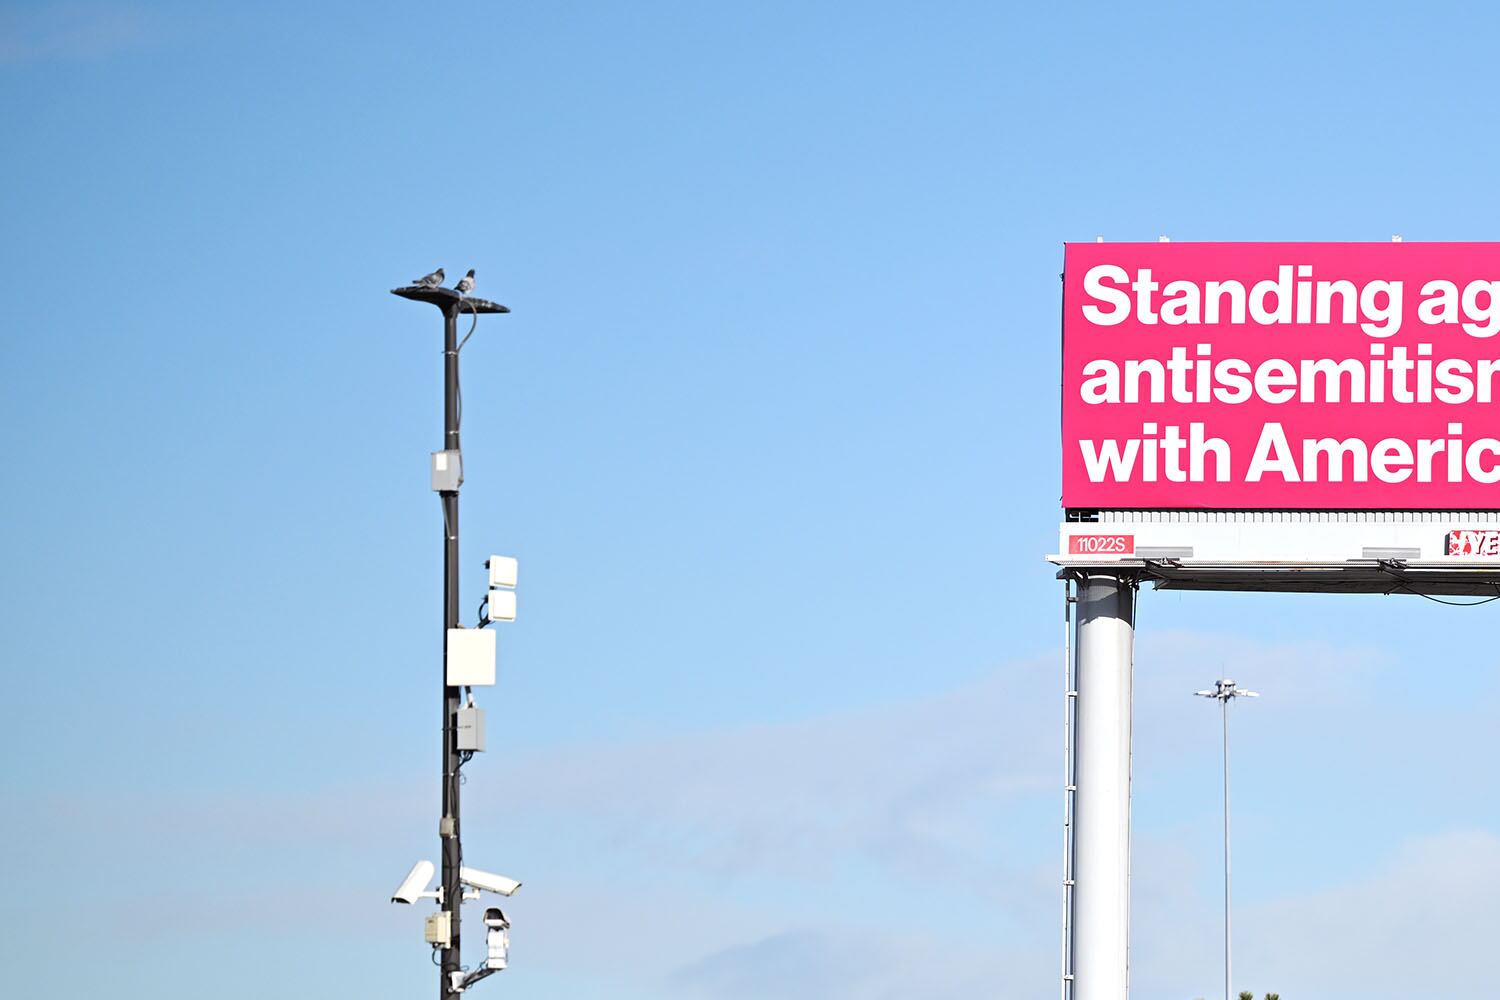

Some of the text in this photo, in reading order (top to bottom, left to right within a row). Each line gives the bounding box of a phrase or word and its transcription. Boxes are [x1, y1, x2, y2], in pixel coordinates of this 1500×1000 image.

[1081, 264, 1404, 338] Standing
[1078, 422, 1231, 483] with
[1077, 537, 1126, 552] 11022S
